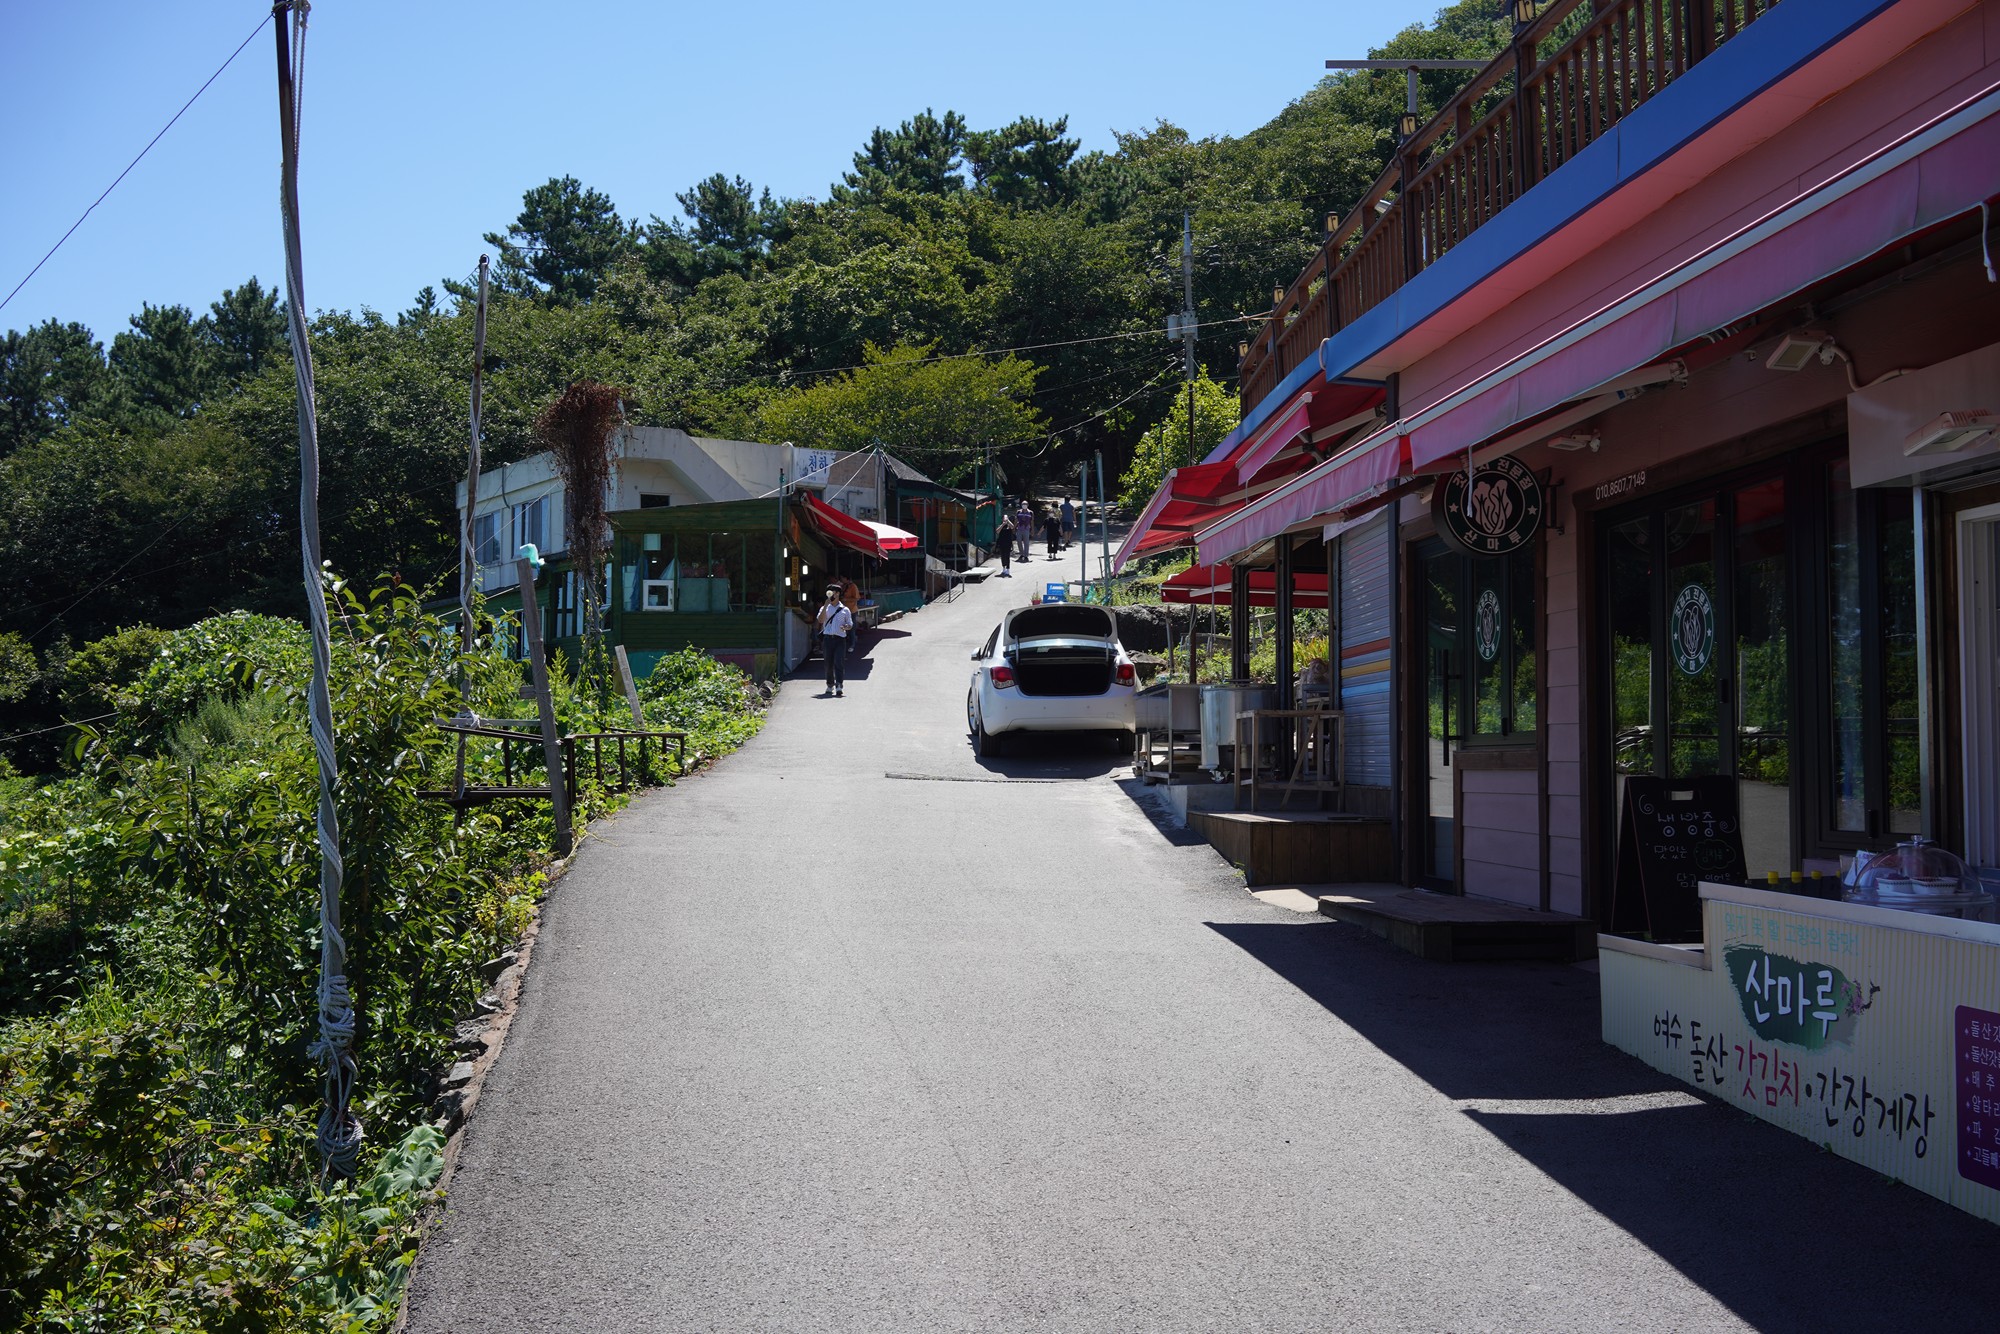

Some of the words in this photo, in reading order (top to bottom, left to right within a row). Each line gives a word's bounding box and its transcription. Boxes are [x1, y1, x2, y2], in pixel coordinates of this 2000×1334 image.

[1496, 458, 1533, 490] 전문점
[1595, 470, 1646, 501] 010.8607.7149
[1463, 529, 1523, 551] 산마루
[1653, 845, 1688, 860] 맛있는
[1724, 912, 1747, 935] 잊지
[1751, 917, 1764, 939] 못
[1767, 919, 1780, 942] 할
[1785, 922, 1822, 947] 고향의
[1827, 928, 1860, 956] 참맛!
[1744, 954, 1839, 1039] 산마루
[1653, 1010, 1683, 1049] 여수
[1689, 1020, 1729, 1085] 돌산
[1734, 1039, 1800, 1108] 갓김치
[1970, 1045, 2000, 1069] 돌산갓
[1972, 1121, 1982, 1139] 파
